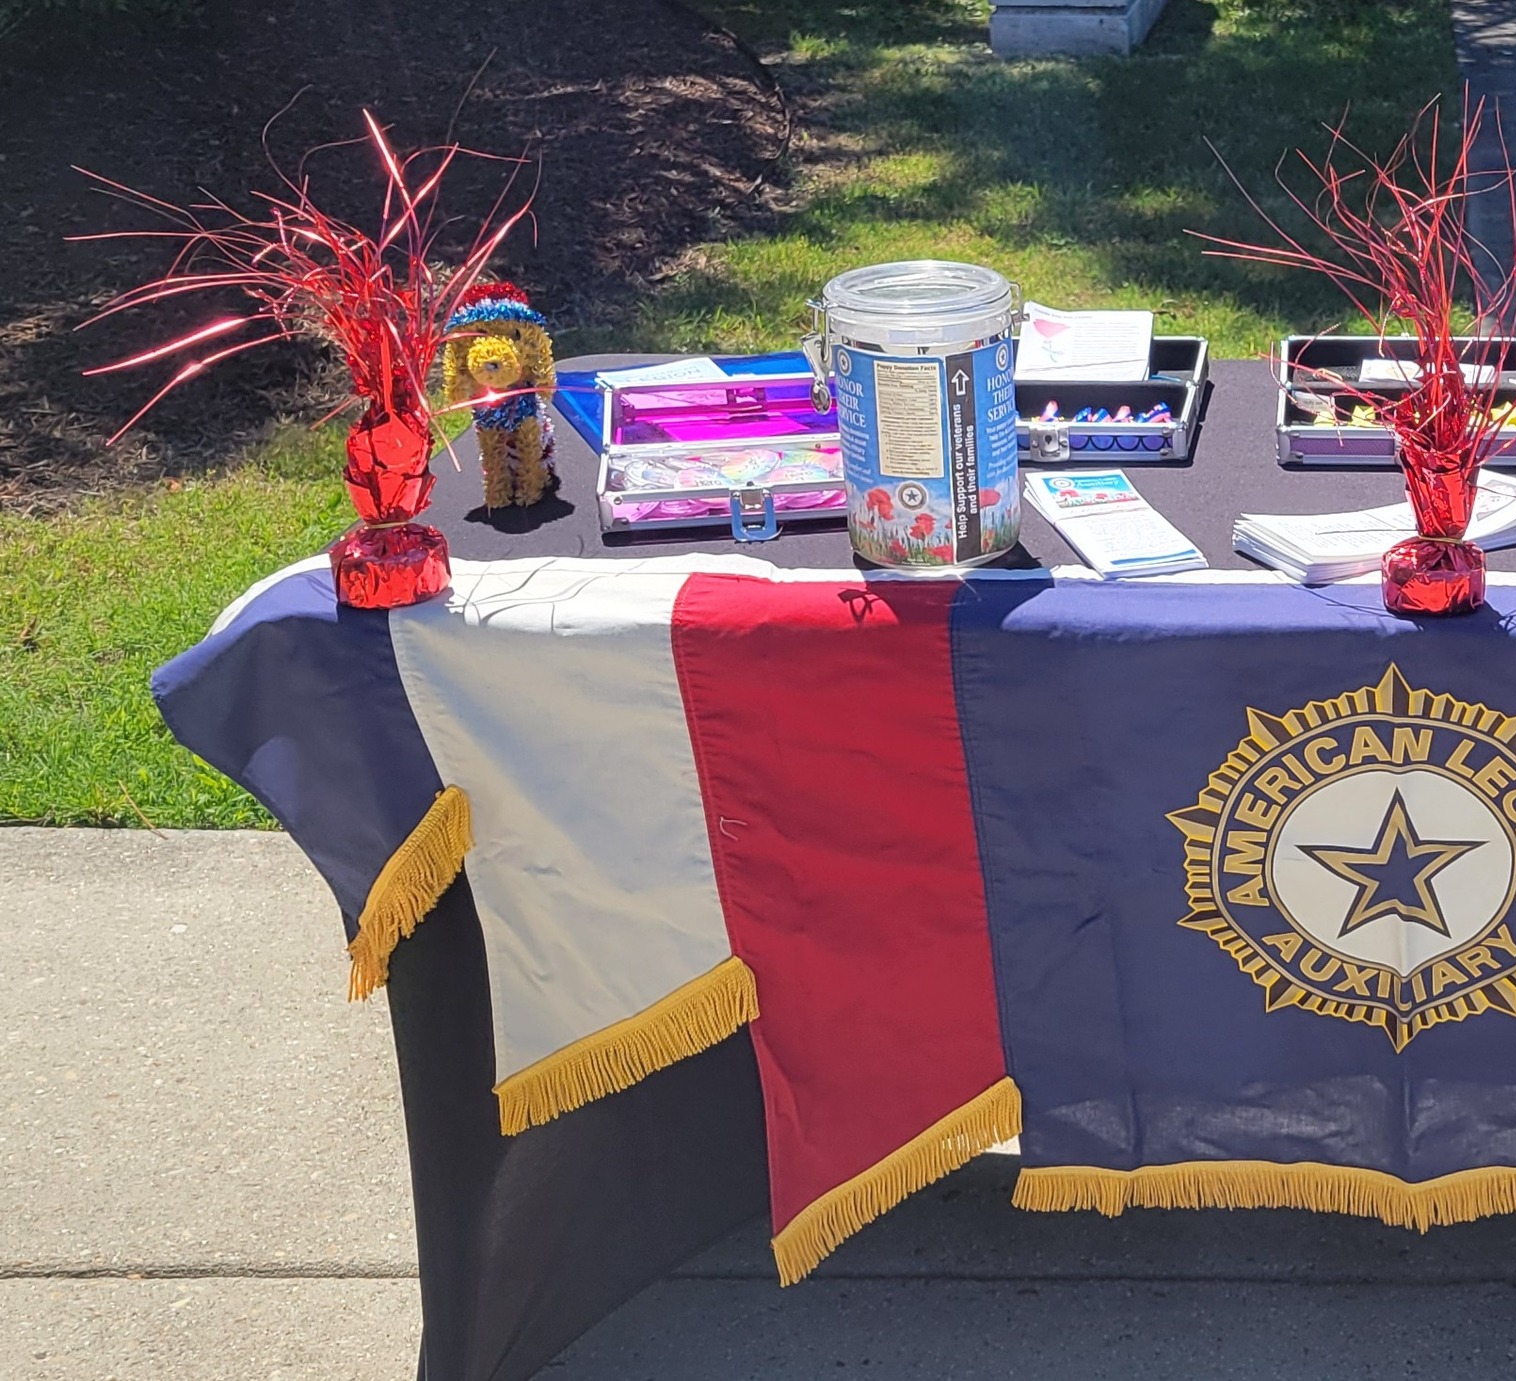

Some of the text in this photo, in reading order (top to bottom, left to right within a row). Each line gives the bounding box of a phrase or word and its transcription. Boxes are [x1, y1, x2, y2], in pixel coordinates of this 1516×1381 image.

[837, 374, 865, 399] ONOR
[987, 369, 1013, 392] HONO
[993, 384, 1013, 406] THEI
[987, 398, 1015, 423] SERVIC
[953, 404, 968, 539] Help Support our veterans
[966, 424, 978, 514] and their families
[1222, 725, 1434, 908] AMERICAN
